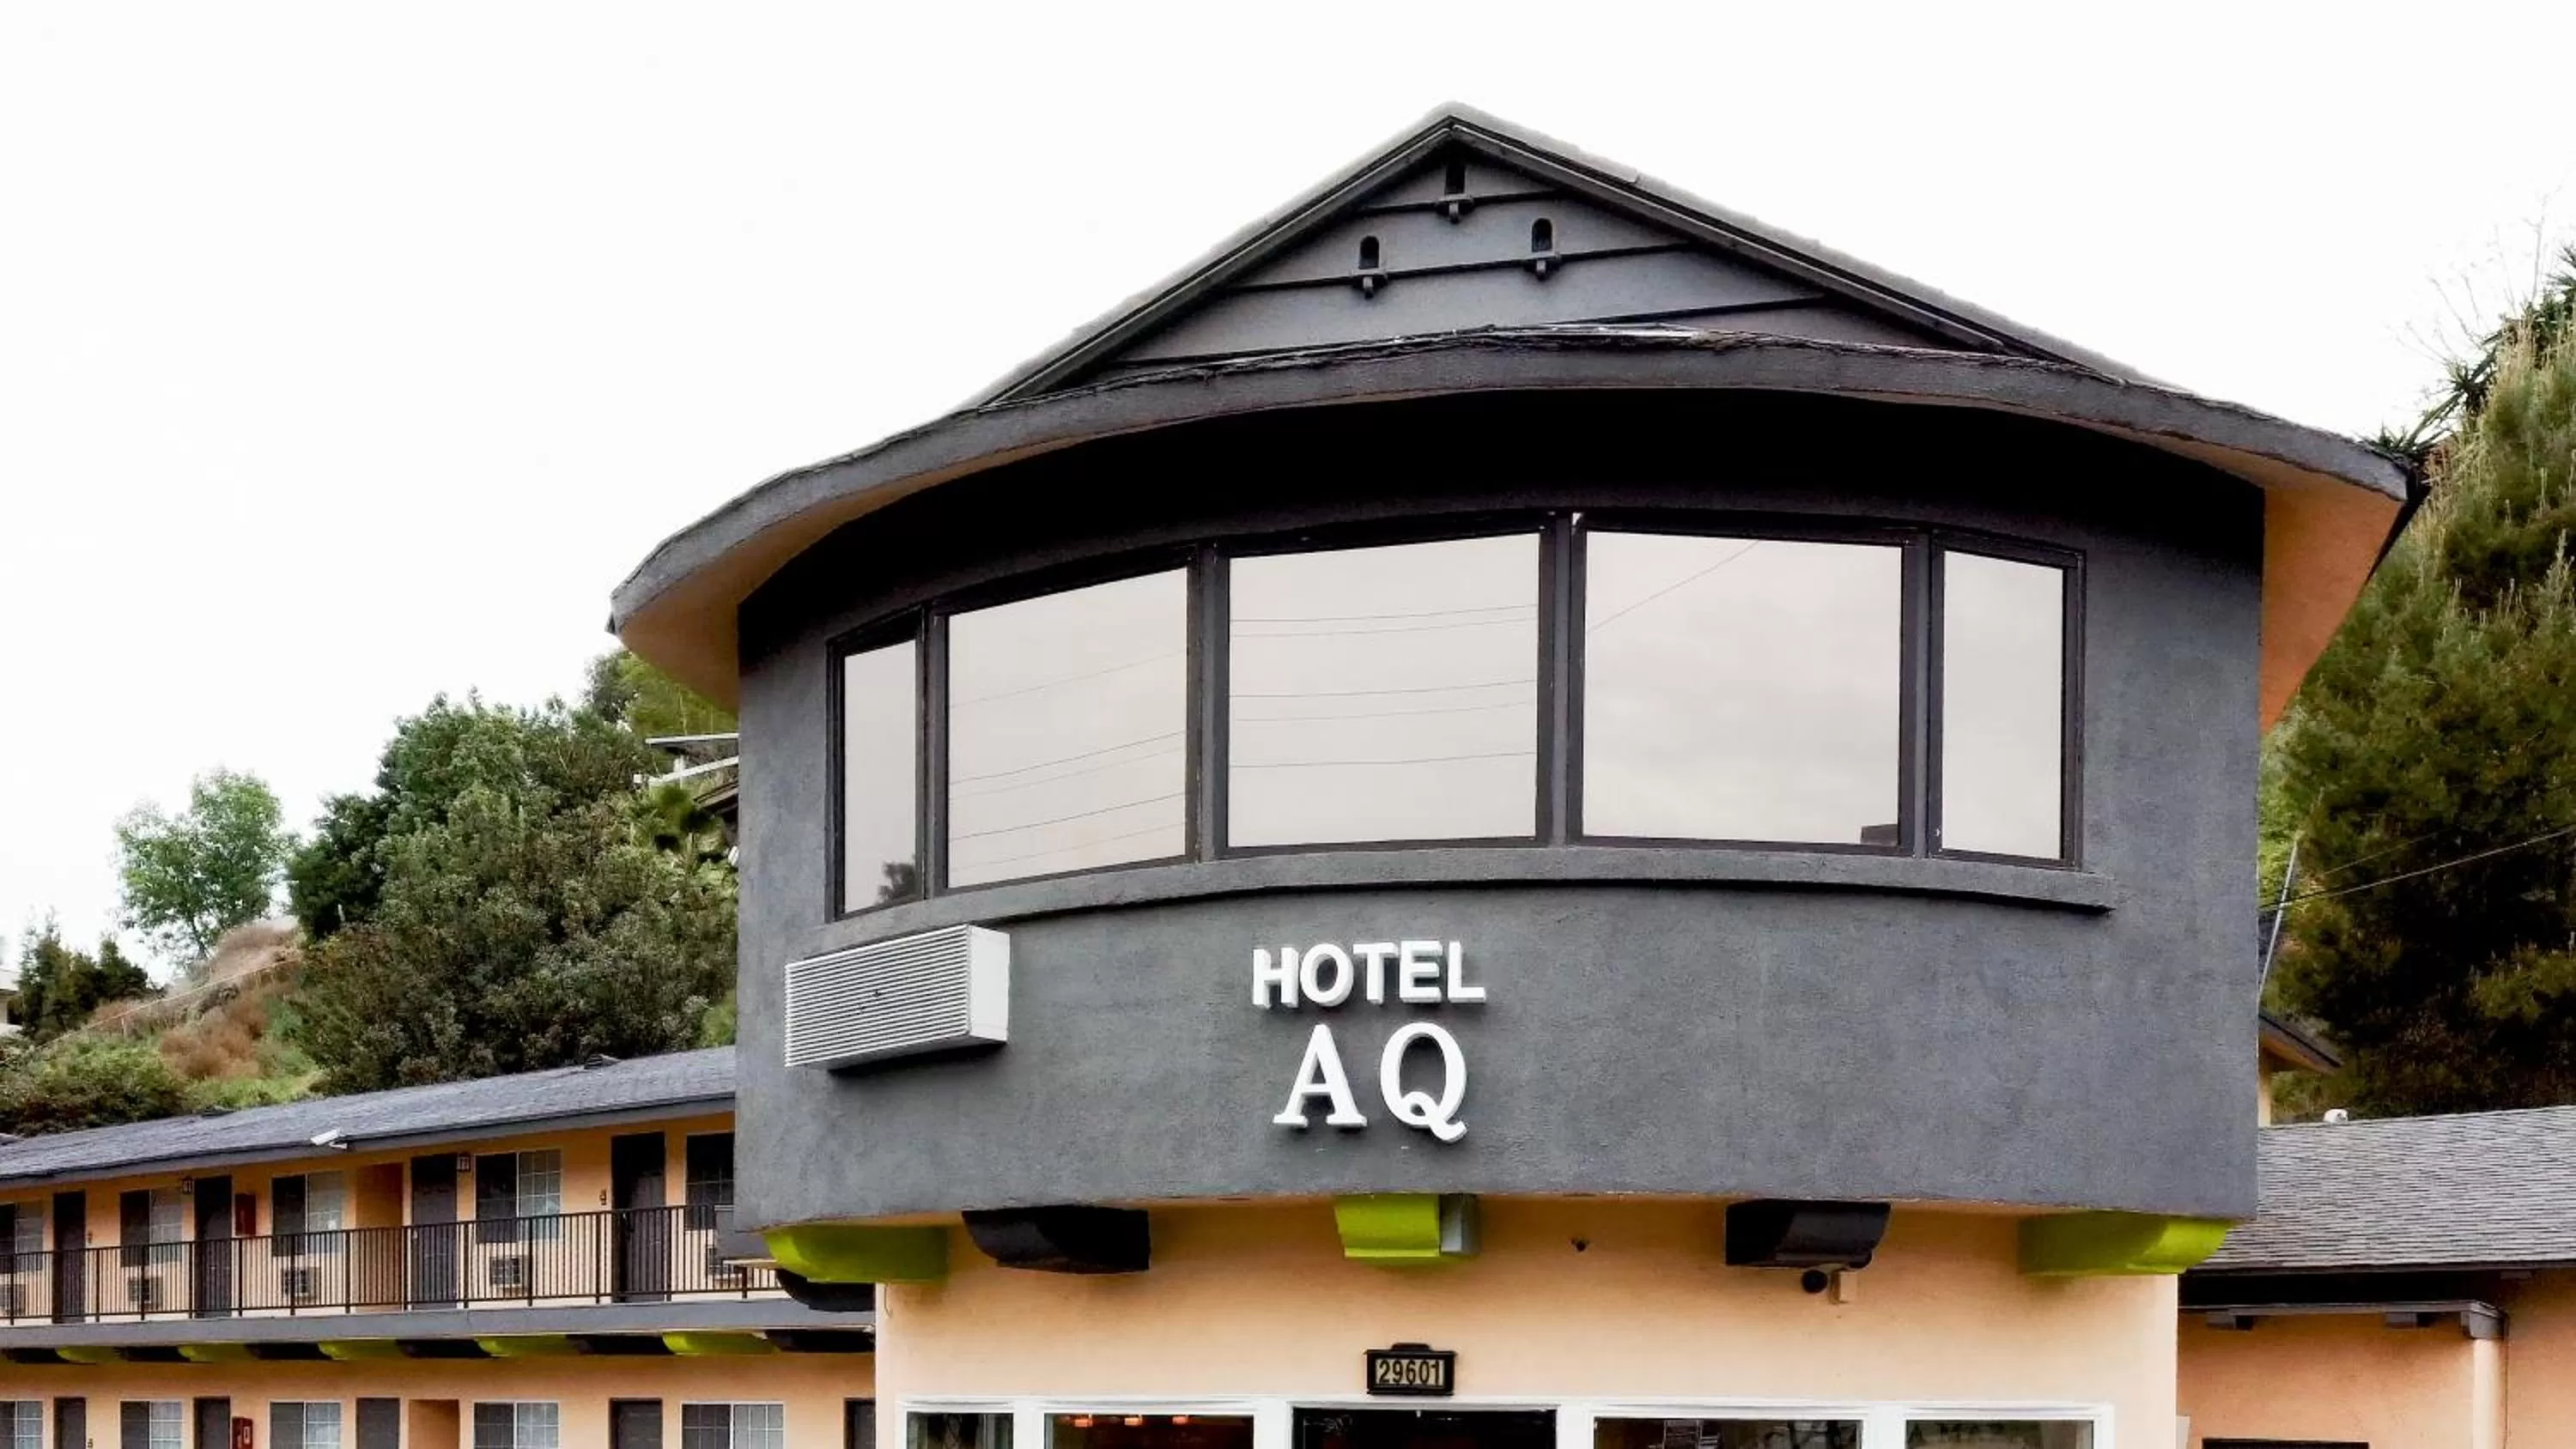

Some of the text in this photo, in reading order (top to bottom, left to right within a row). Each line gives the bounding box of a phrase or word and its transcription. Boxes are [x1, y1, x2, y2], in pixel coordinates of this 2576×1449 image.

[1253, 941, 1485, 1008] HOTEL
[1273, 1022, 1467, 1142] AQ
[1378, 1359, 1441, 1385] 29601
